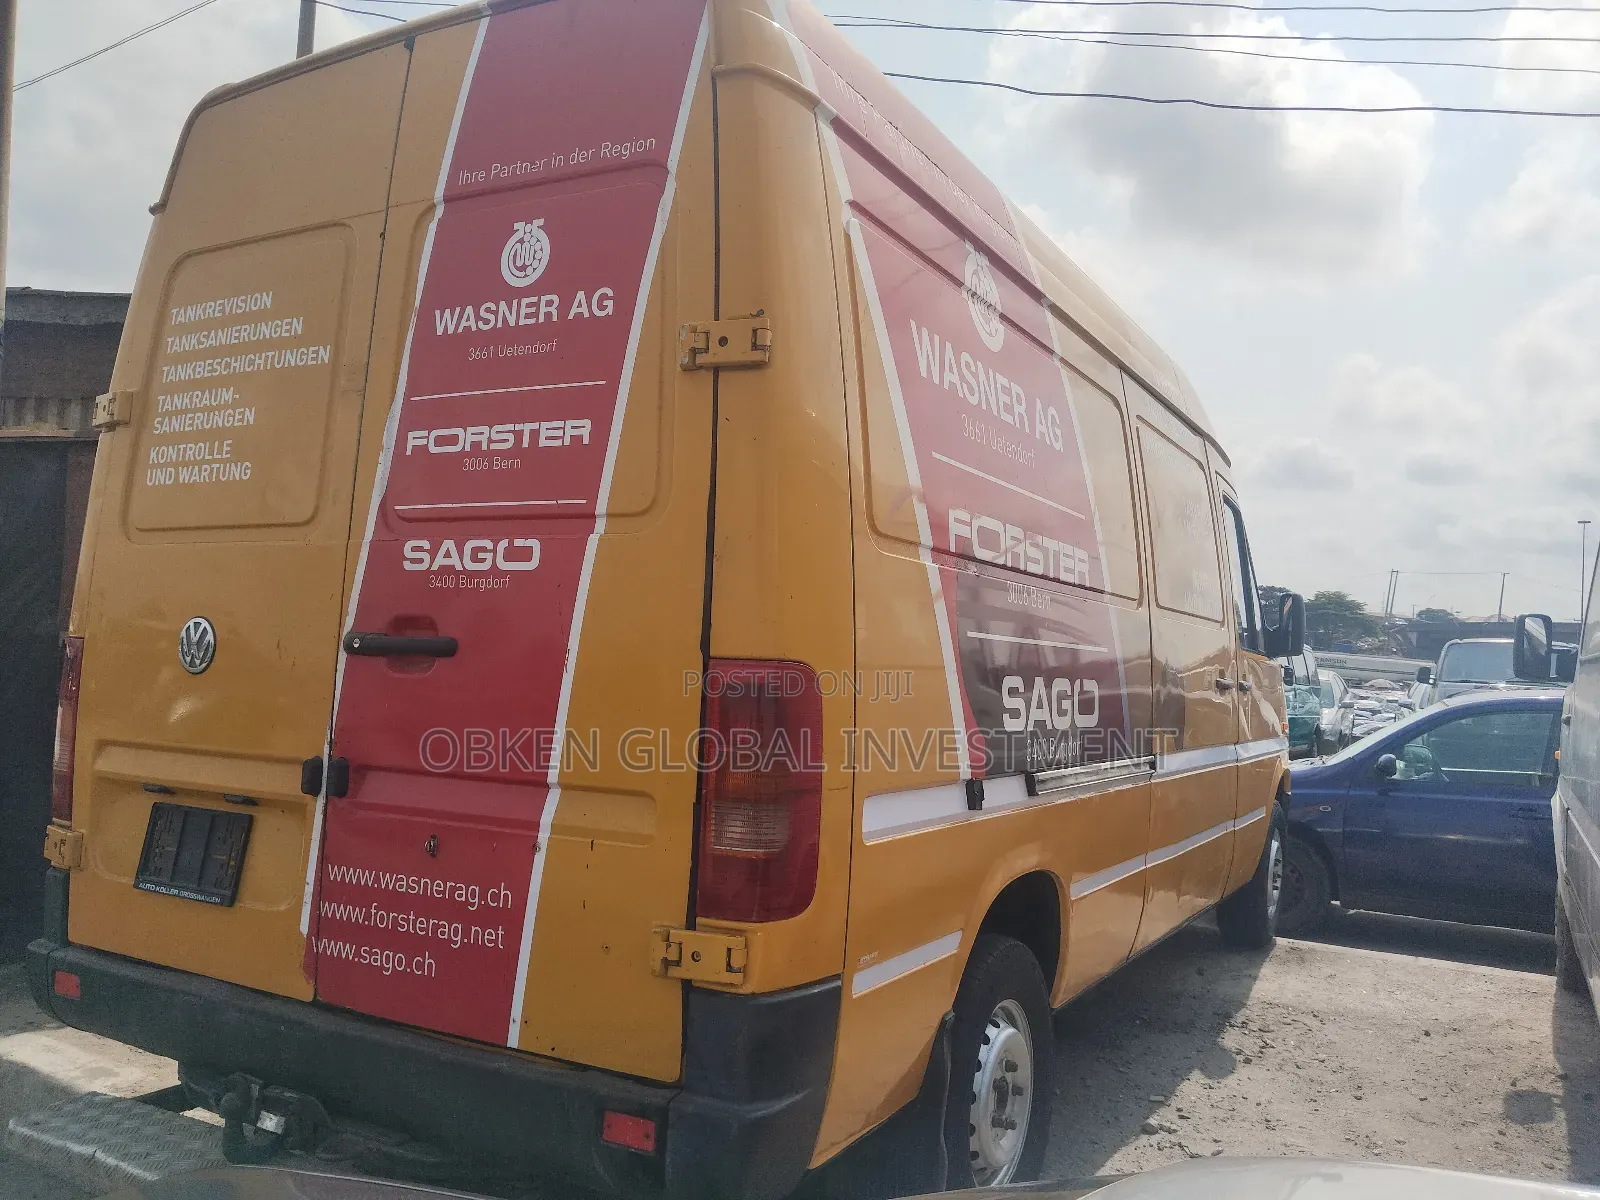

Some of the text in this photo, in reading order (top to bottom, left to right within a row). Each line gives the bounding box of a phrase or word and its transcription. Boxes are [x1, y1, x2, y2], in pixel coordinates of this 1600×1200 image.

[459, 136, 656, 185] Ihre Partner in der Region
[170, 291, 273, 326] TANKREVISION
[434, 286, 614, 336] WASNER AG
[166, 316, 304, 355] TANKSANIERUNGEN
[467, 338, 558, 361] 3661 Uetendorf
[161, 344, 331, 384] TANKBESCHICHTUNGEN
[156, 386, 240, 414] TANKRAUM-
[909, 317, 1031, 434] WASNER
[1034, 396, 1064, 453] AG
[152, 406, 256, 435] SANIERUNGEN
[405, 418, 592, 456] FORSTER
[149, 439, 233, 465] KONTROLLE
[462, 456, 521, 471] 3006 Bern
[146, 461, 252, 486] UND WARTUNG
[402, 538, 541, 571] SAGO
[948, 508, 1090, 587] FORSTER
[428, 574, 510, 592] 3400 Burgdorf
[1002, 675, 1099, 732] SAGO
[328, 863, 512, 911] www.wasnerag.ch
[319, 900, 505, 949] www.forsterag.net
[311, 936, 436, 978] www.sago.ch
